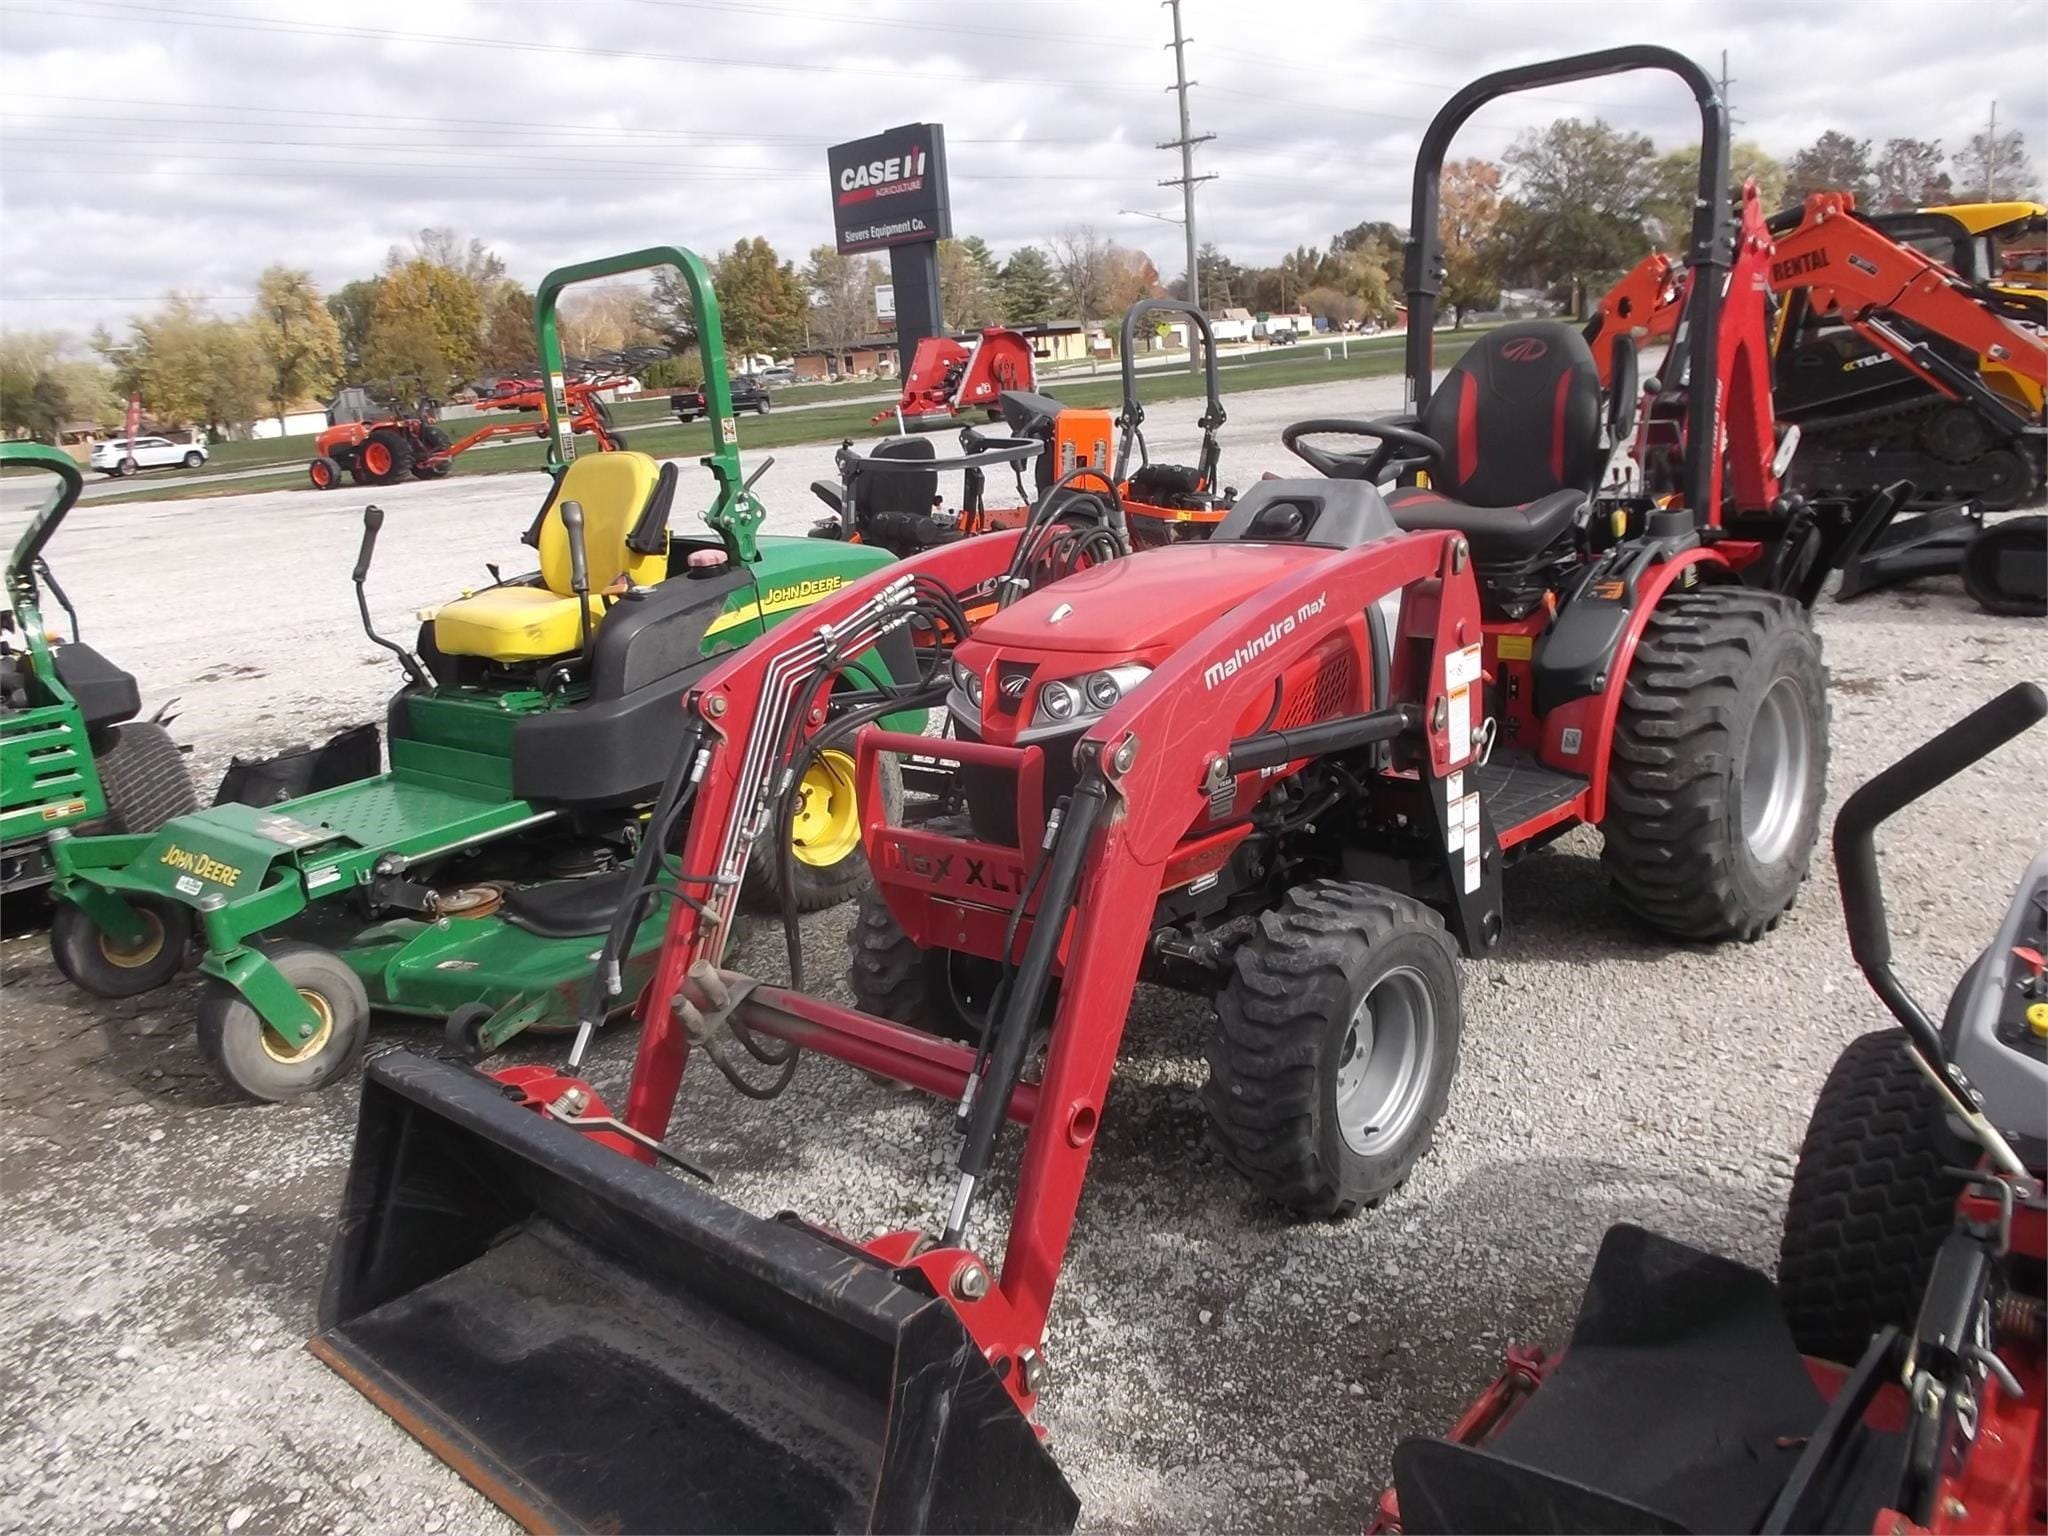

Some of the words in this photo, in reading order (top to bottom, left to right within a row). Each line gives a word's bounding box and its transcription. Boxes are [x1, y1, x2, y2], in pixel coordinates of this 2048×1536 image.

[840, 157, 900, 191] CASE
[875, 180, 921, 197] AGRICULTURE
[845, 228, 869, 242] Sievers
[871, 220, 910, 238] Equipment
[912, 217, 926, 231] Co.
[1773, 248, 1830, 281] RENTAL
[764, 585, 799, 605] JOHN
[800, 576, 841, 597] DEERE
[1204, 615, 1295, 691] Mahindra
[160, 844, 195, 872] JOHN
[193, 853, 241, 888] DEERE
[965, 856, 1028, 895] XLT
